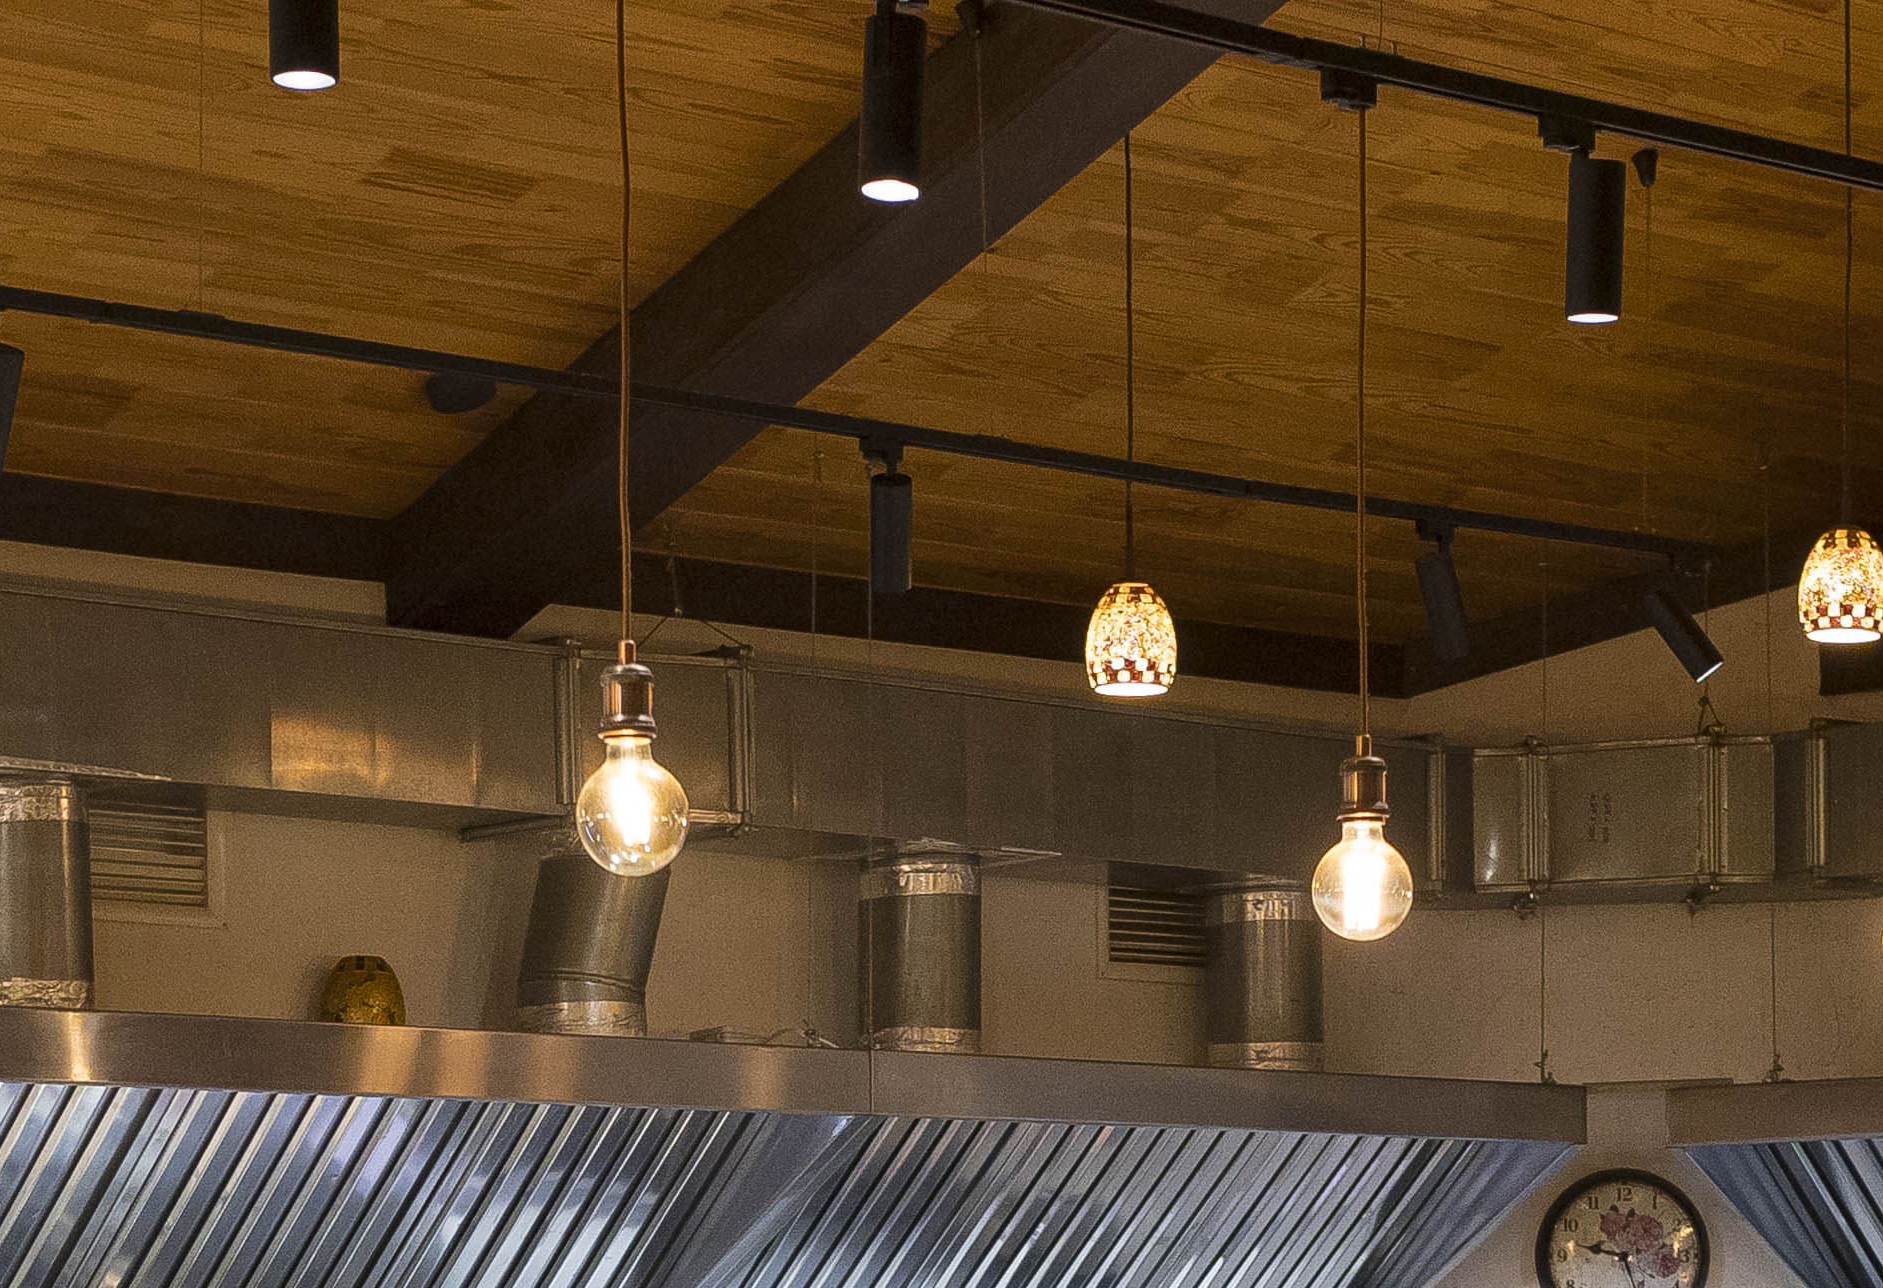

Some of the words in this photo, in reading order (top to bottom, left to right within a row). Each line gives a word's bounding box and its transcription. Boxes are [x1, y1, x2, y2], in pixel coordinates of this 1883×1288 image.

[1617, 1187, 1633, 1201] 12
[1652, 1192, 1658, 1210] 1
[1588, 1196, 1600, 1210] 11
[1563, 1219, 1578, 1233] 10
[1557, 1250, 1567, 1263] 9
[1680, 1250, 1690, 1263] 3
